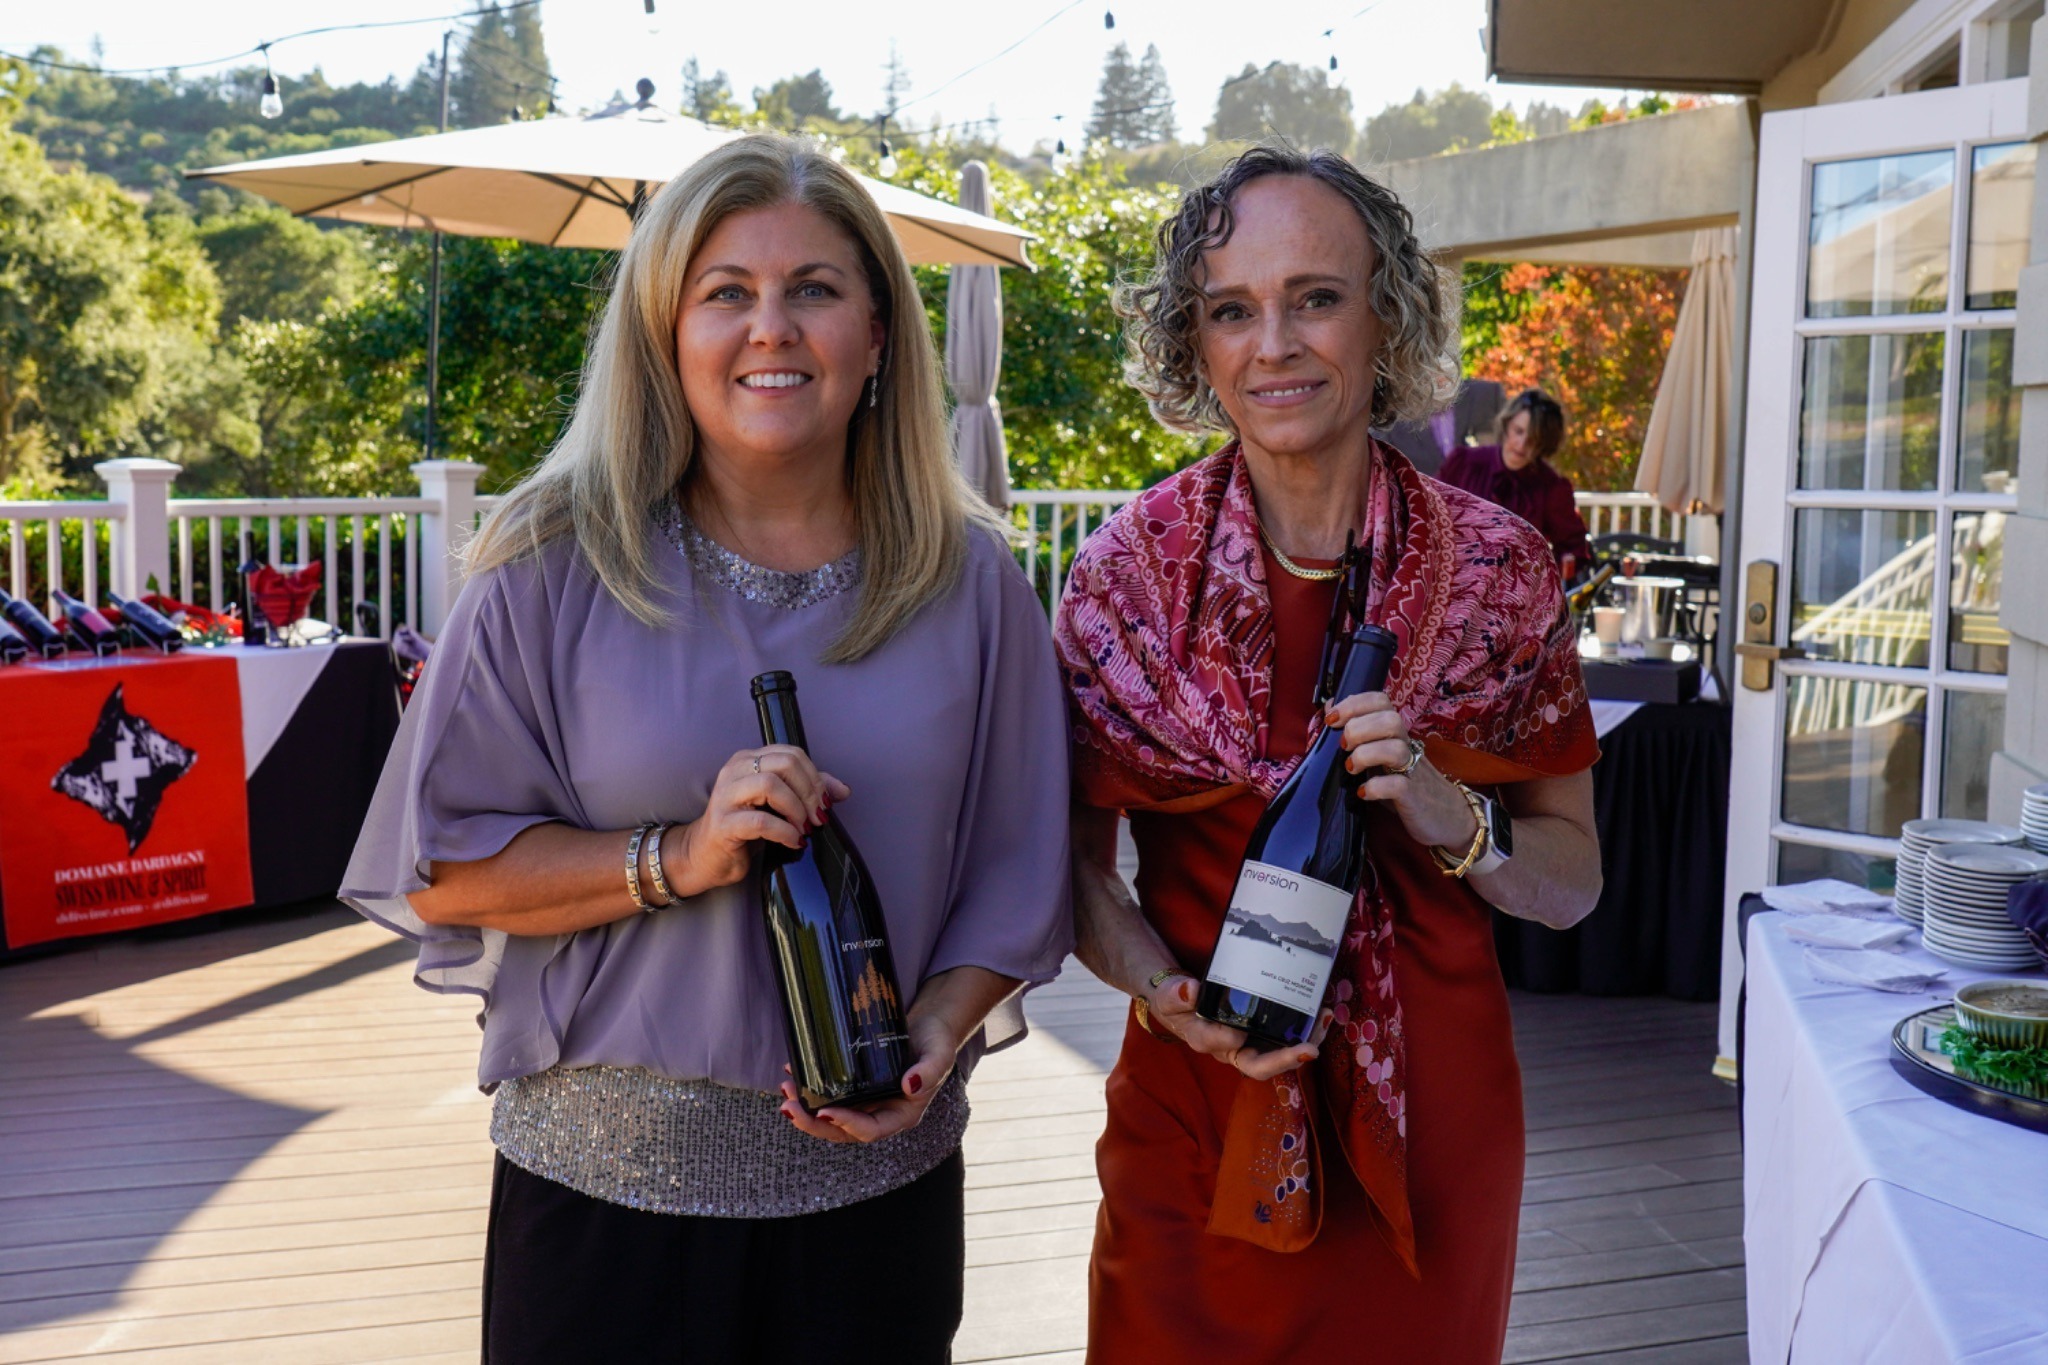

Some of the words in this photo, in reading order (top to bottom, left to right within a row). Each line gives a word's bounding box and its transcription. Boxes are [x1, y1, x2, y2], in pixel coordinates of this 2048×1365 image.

[55, 860, 128, 884] DOMAINE
[130, 850, 205, 873] DARDAGNY
[1243, 864, 1299, 892] inversion
[56, 879, 103, 909] SWISS
[103, 874, 144, 901] WINE
[147, 872, 160, 897] &
[162, 865, 206, 894] SPIRIT
[841, 936, 885, 952] inversion
